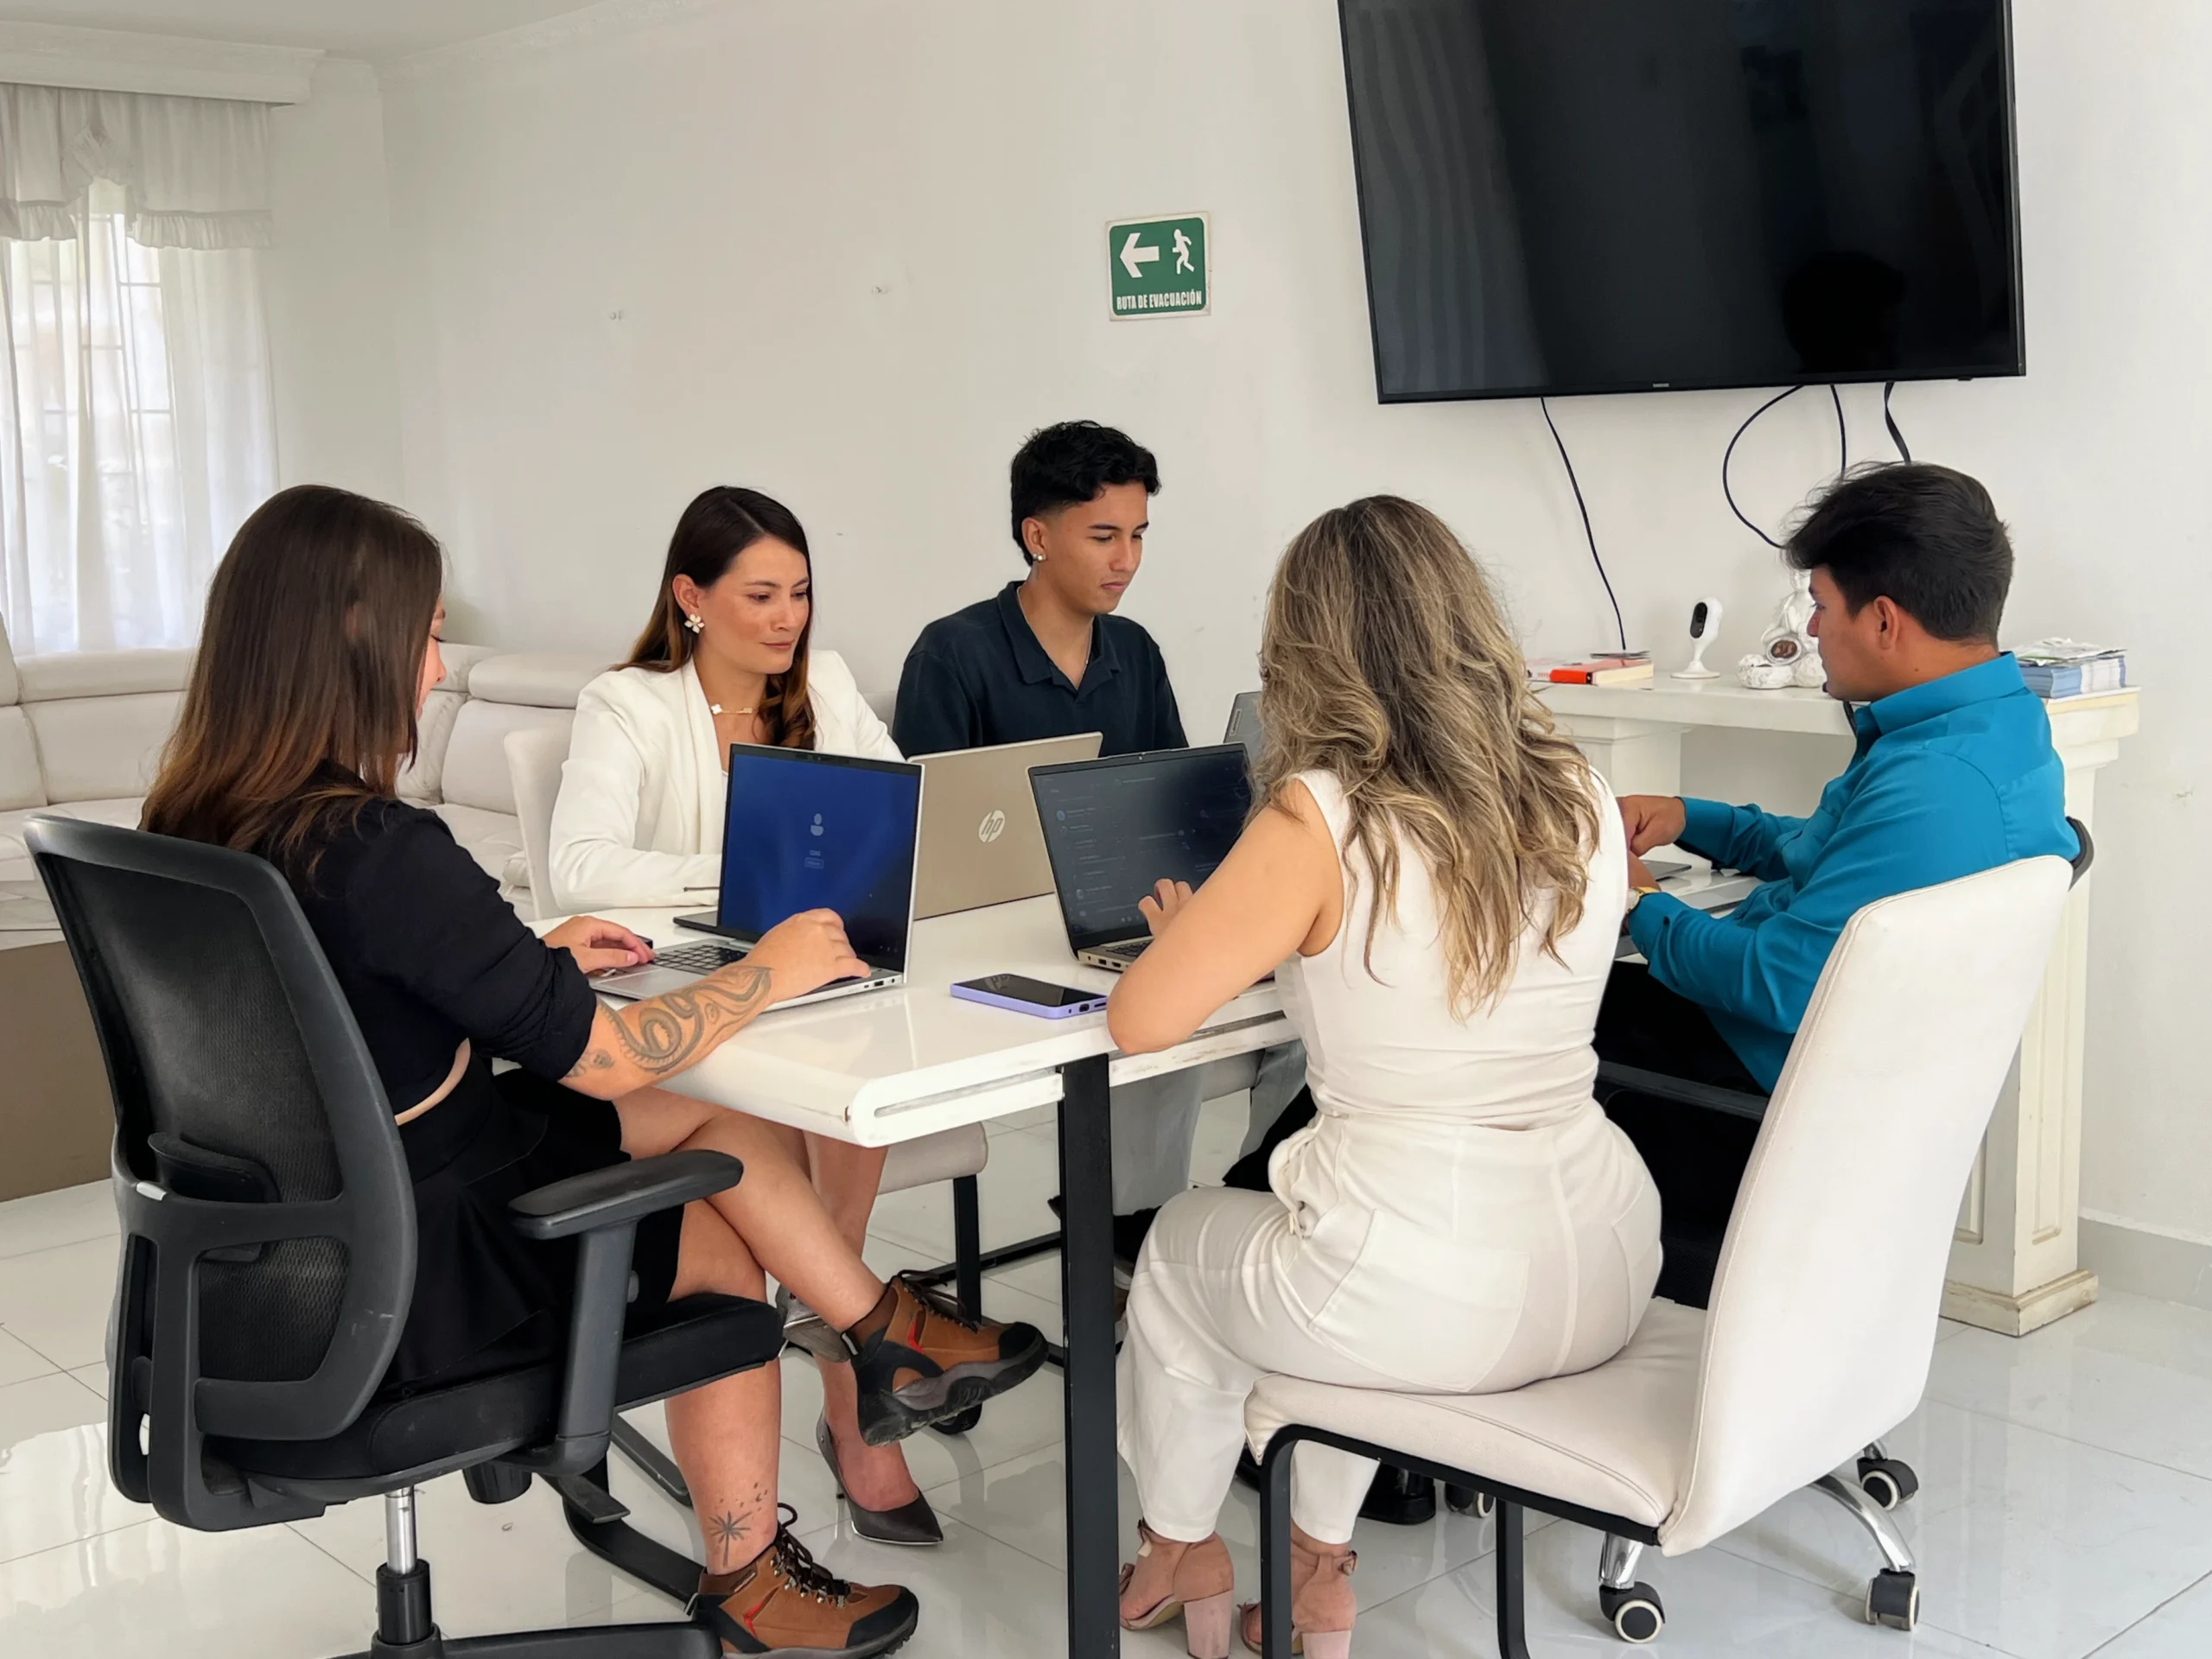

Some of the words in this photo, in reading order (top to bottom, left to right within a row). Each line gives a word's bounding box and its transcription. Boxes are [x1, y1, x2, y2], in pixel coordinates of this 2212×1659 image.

[1116, 296, 1137, 310] RUTA
[1138, 295, 1147, 308] DE
[1149, 289, 1202, 308] EVACUACIÓN
[979, 810, 1005, 842] hp
